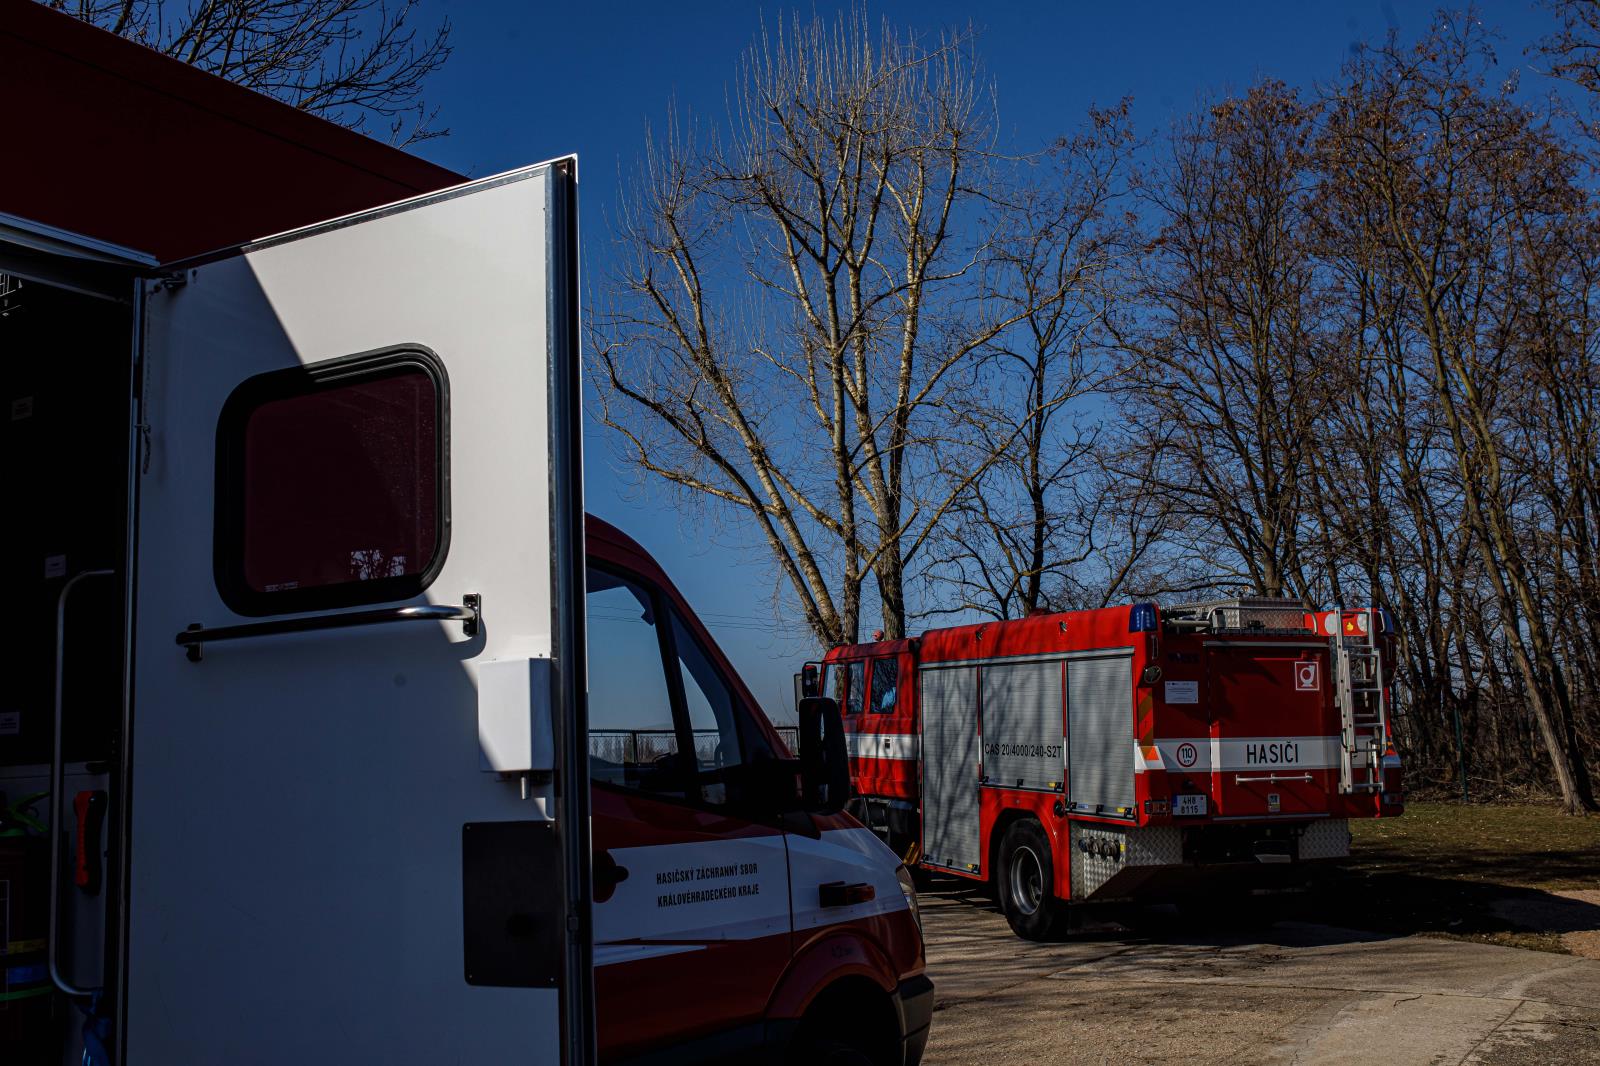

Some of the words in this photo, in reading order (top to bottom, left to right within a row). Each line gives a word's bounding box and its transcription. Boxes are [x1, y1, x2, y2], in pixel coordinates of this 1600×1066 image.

[985, 743, 1000, 755] CAS
[1181, 748, 1193, 759] 110
[1246, 741, 1299, 764] HASIČI
[656, 867, 694, 885] HASIČSKÝ
[696, 863, 738, 880] ZÁCHRANNÝ
[740, 863, 758, 875] SBOR
[738, 884, 760, 897] KRAJE
